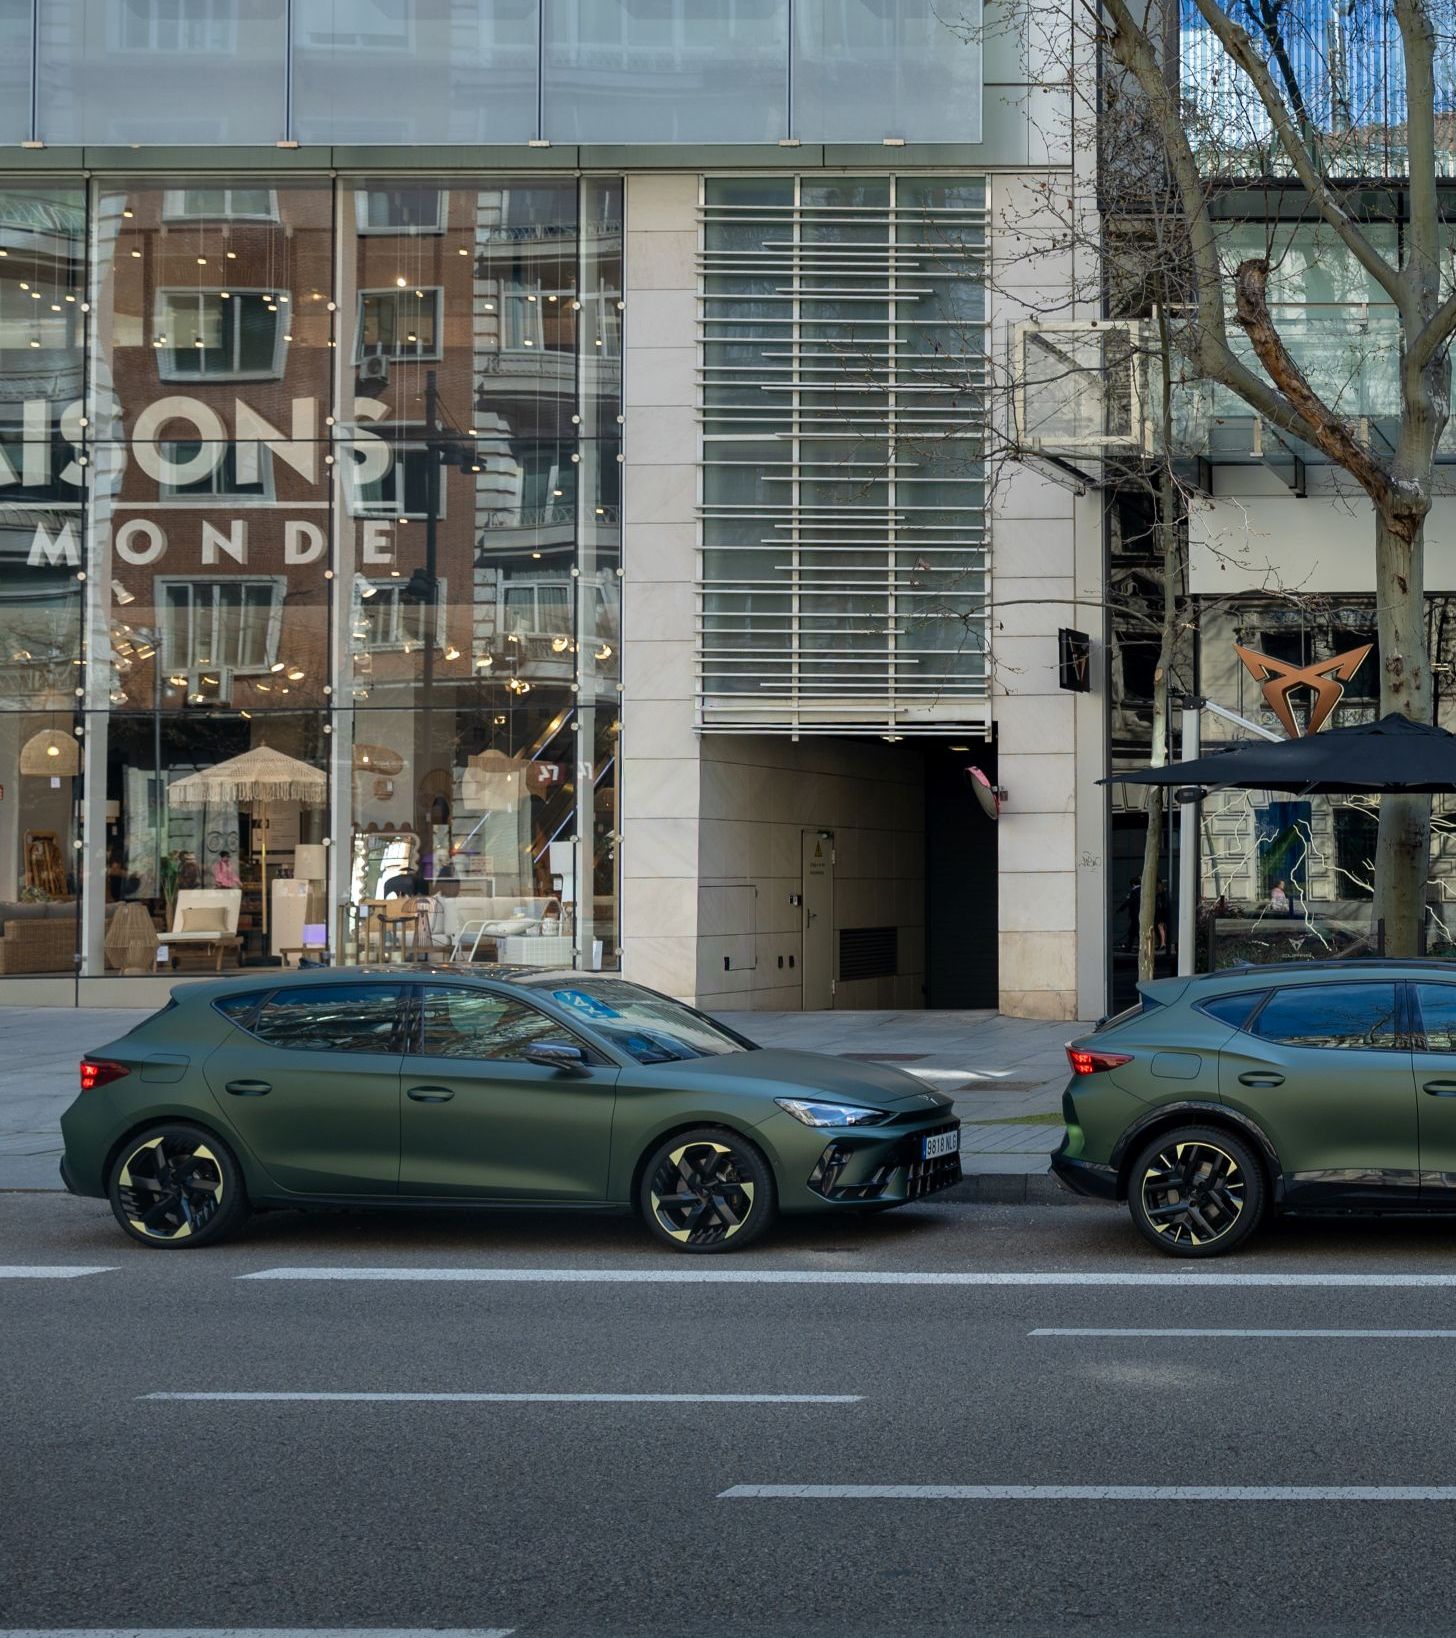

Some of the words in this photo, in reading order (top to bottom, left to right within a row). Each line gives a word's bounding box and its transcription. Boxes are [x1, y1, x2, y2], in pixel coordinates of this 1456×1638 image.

[0, 396, 394, 487] ISONS
[26, 519, 395, 567] MONDE
[928, 1137, 944, 1155] 9818
